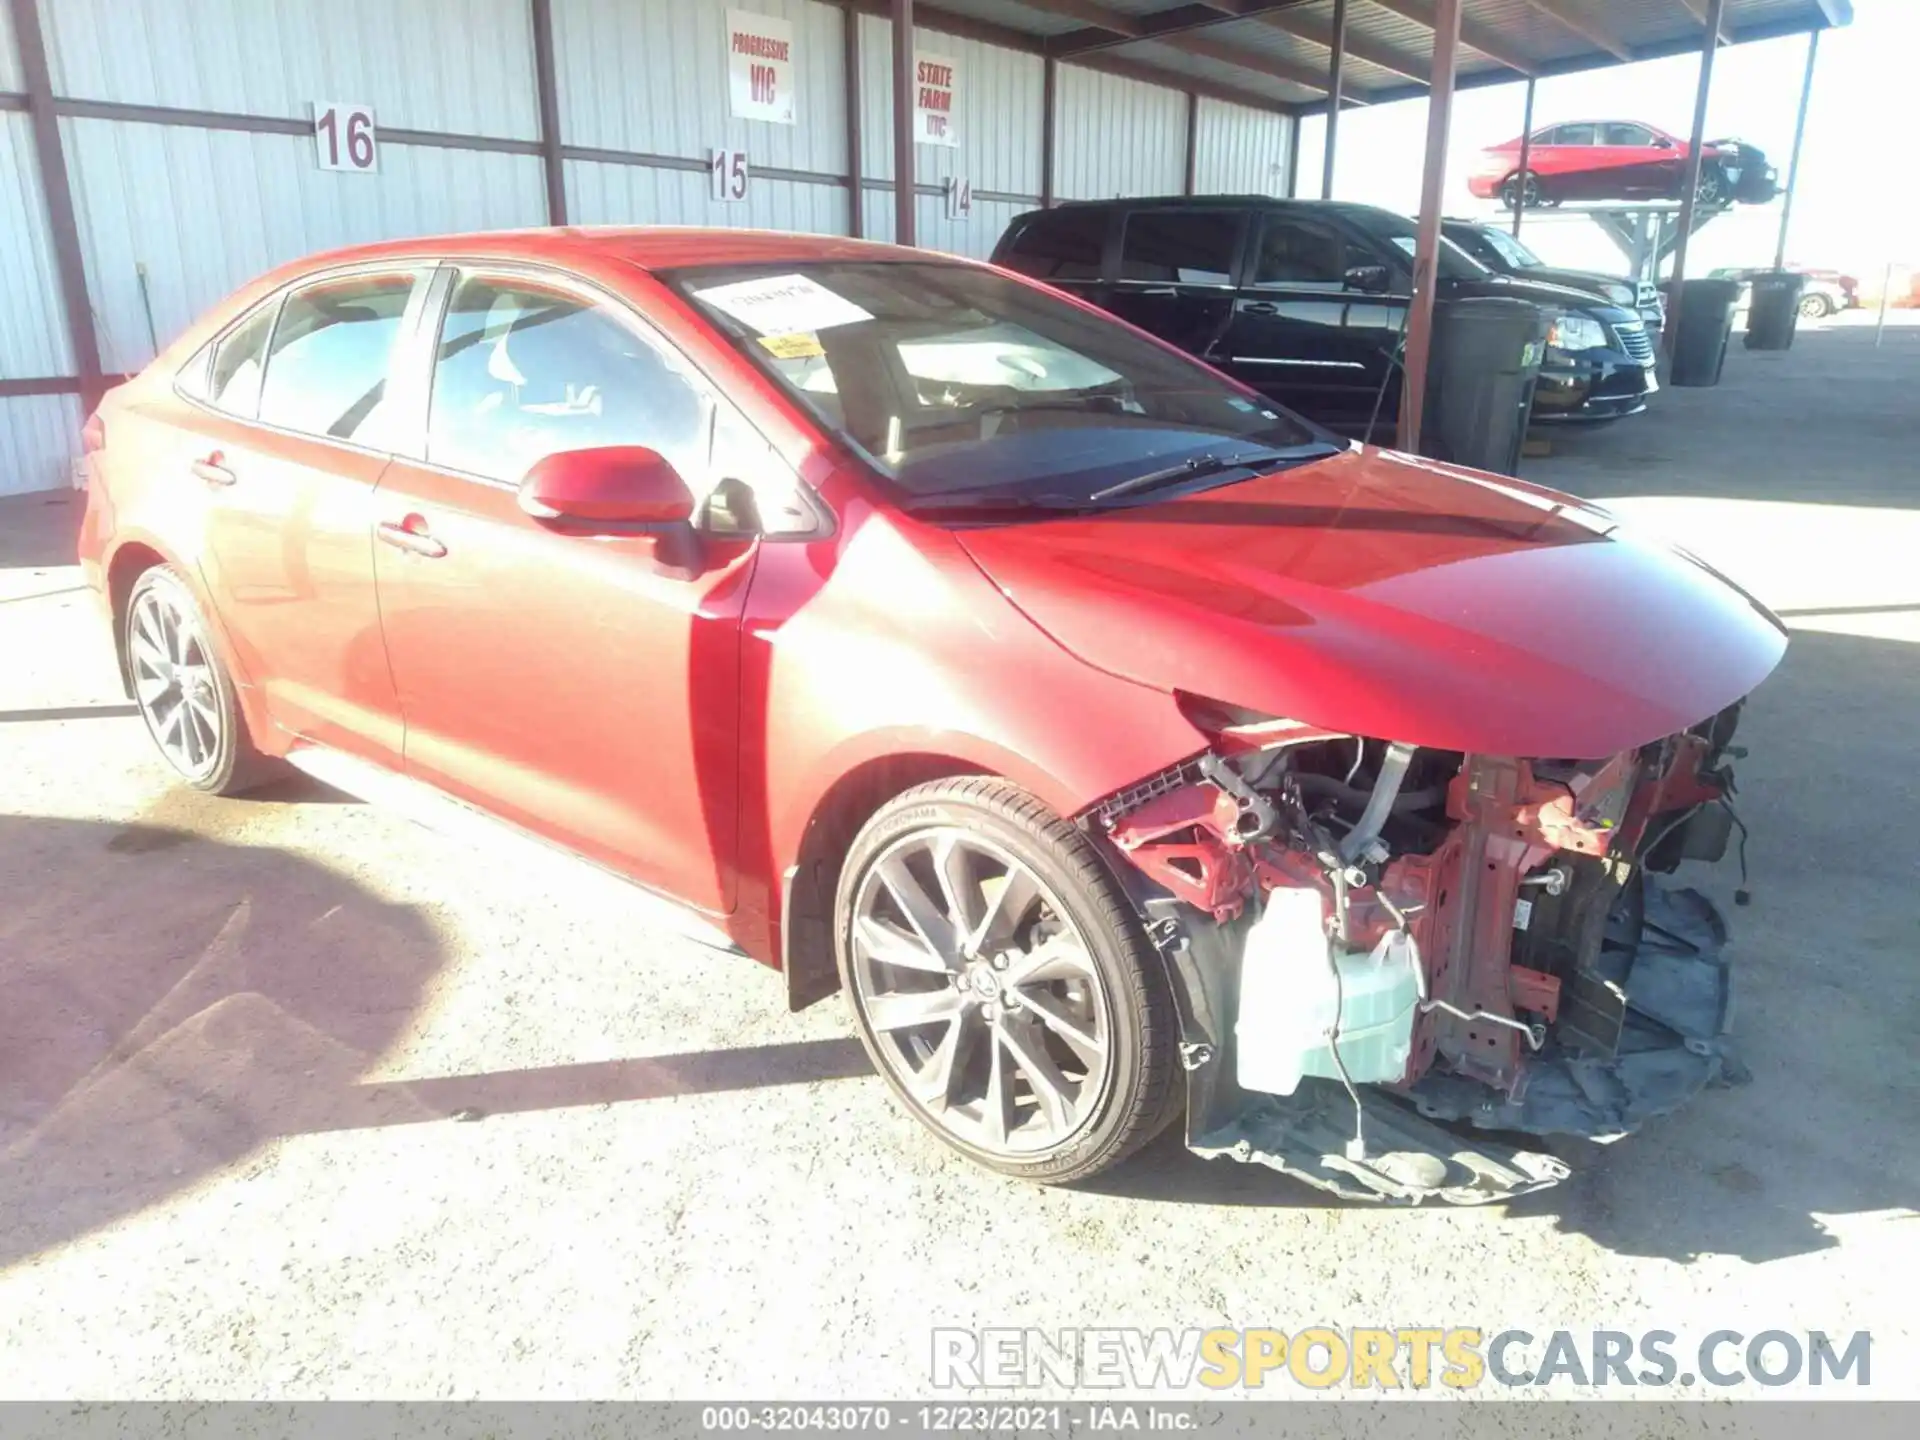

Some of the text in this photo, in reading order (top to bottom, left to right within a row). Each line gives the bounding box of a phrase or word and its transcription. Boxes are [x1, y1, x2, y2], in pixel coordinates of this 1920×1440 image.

[732, 32, 789, 62] PROGRESSIVE
[751, 63, 776, 105] VIC
[917, 61, 952, 87] STATE
[919, 87, 952, 112] FARM
[318, 108, 373, 168] 16
[927, 114, 946, 138] VIC
[715, 151, 747, 199] 15
[950, 177, 971, 217] 14
